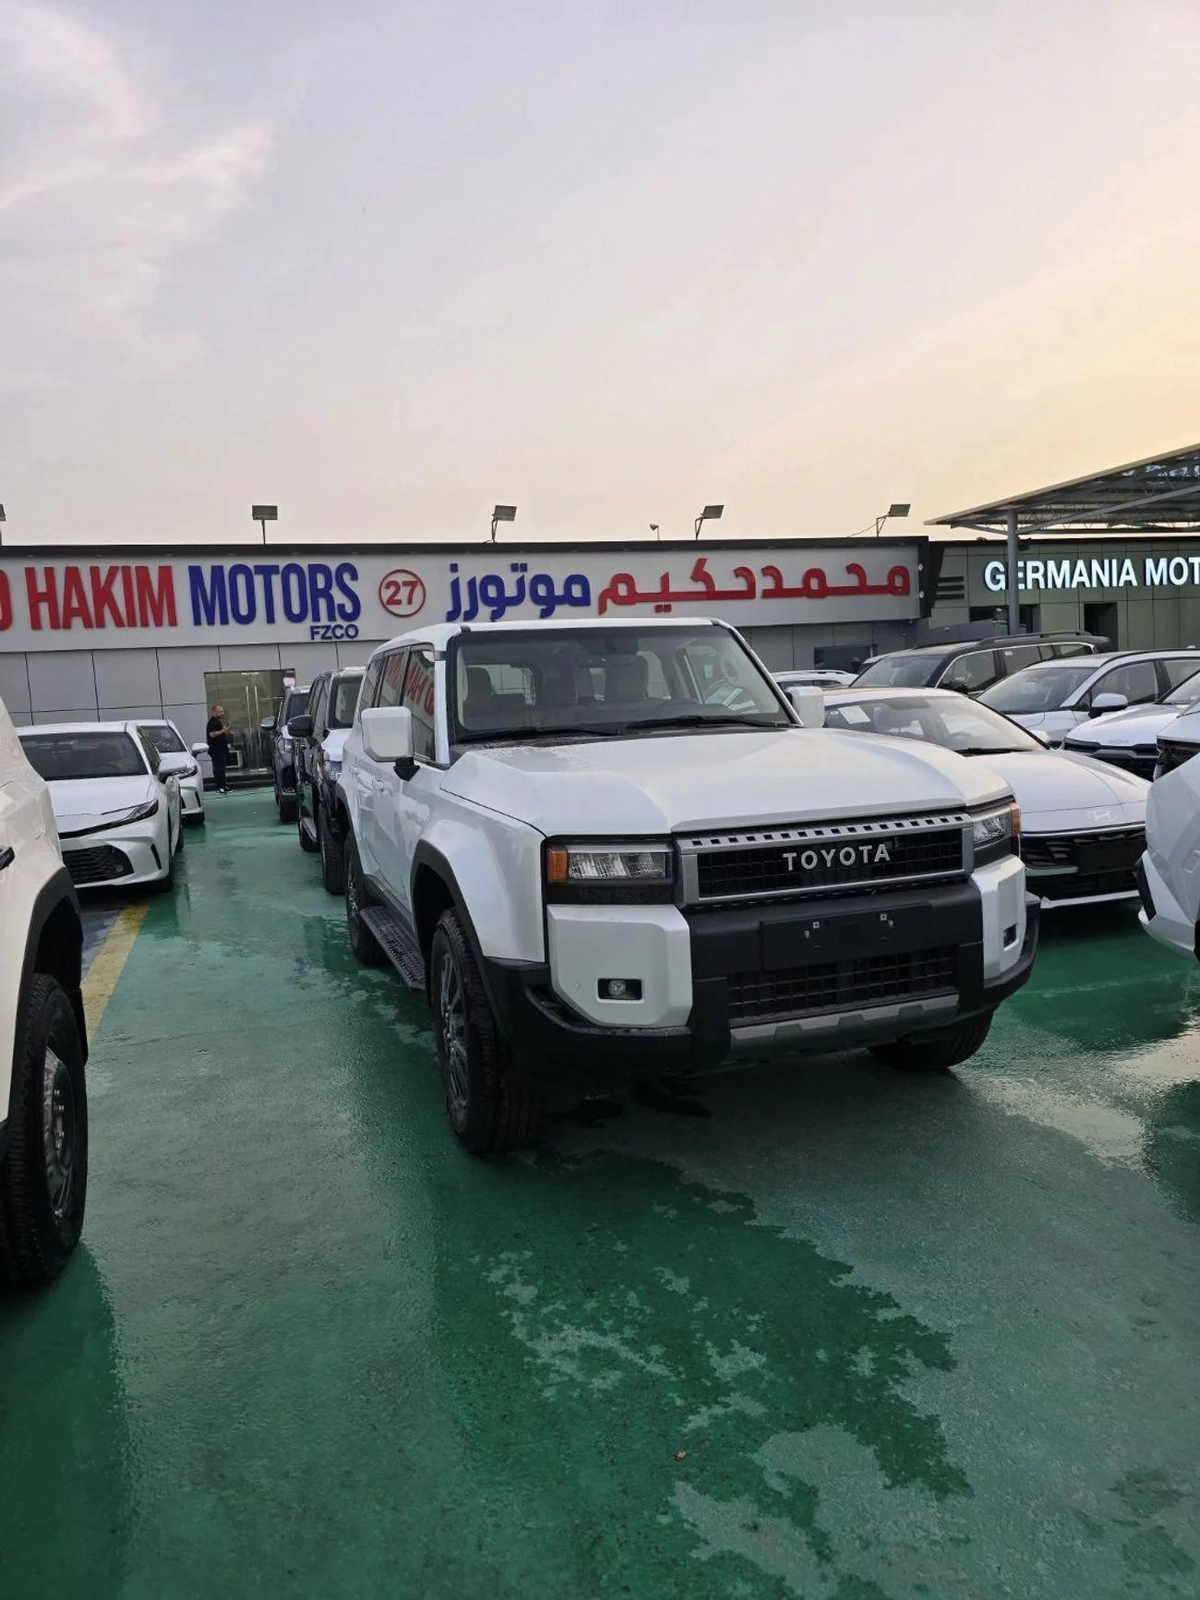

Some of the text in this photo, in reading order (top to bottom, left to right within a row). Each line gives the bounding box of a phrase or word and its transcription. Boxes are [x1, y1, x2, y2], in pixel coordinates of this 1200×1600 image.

[1145, 556, 1200, 586] MOT
[24, 565, 178, 630] HAKIM
[188, 562, 361, 626] MOTORS
[384, 580, 419, 606] 27
[446, 563, 591, 622] موتورز
[310, 624, 359, 640] FZCO
[782, 844, 891, 871] TOYOTA
